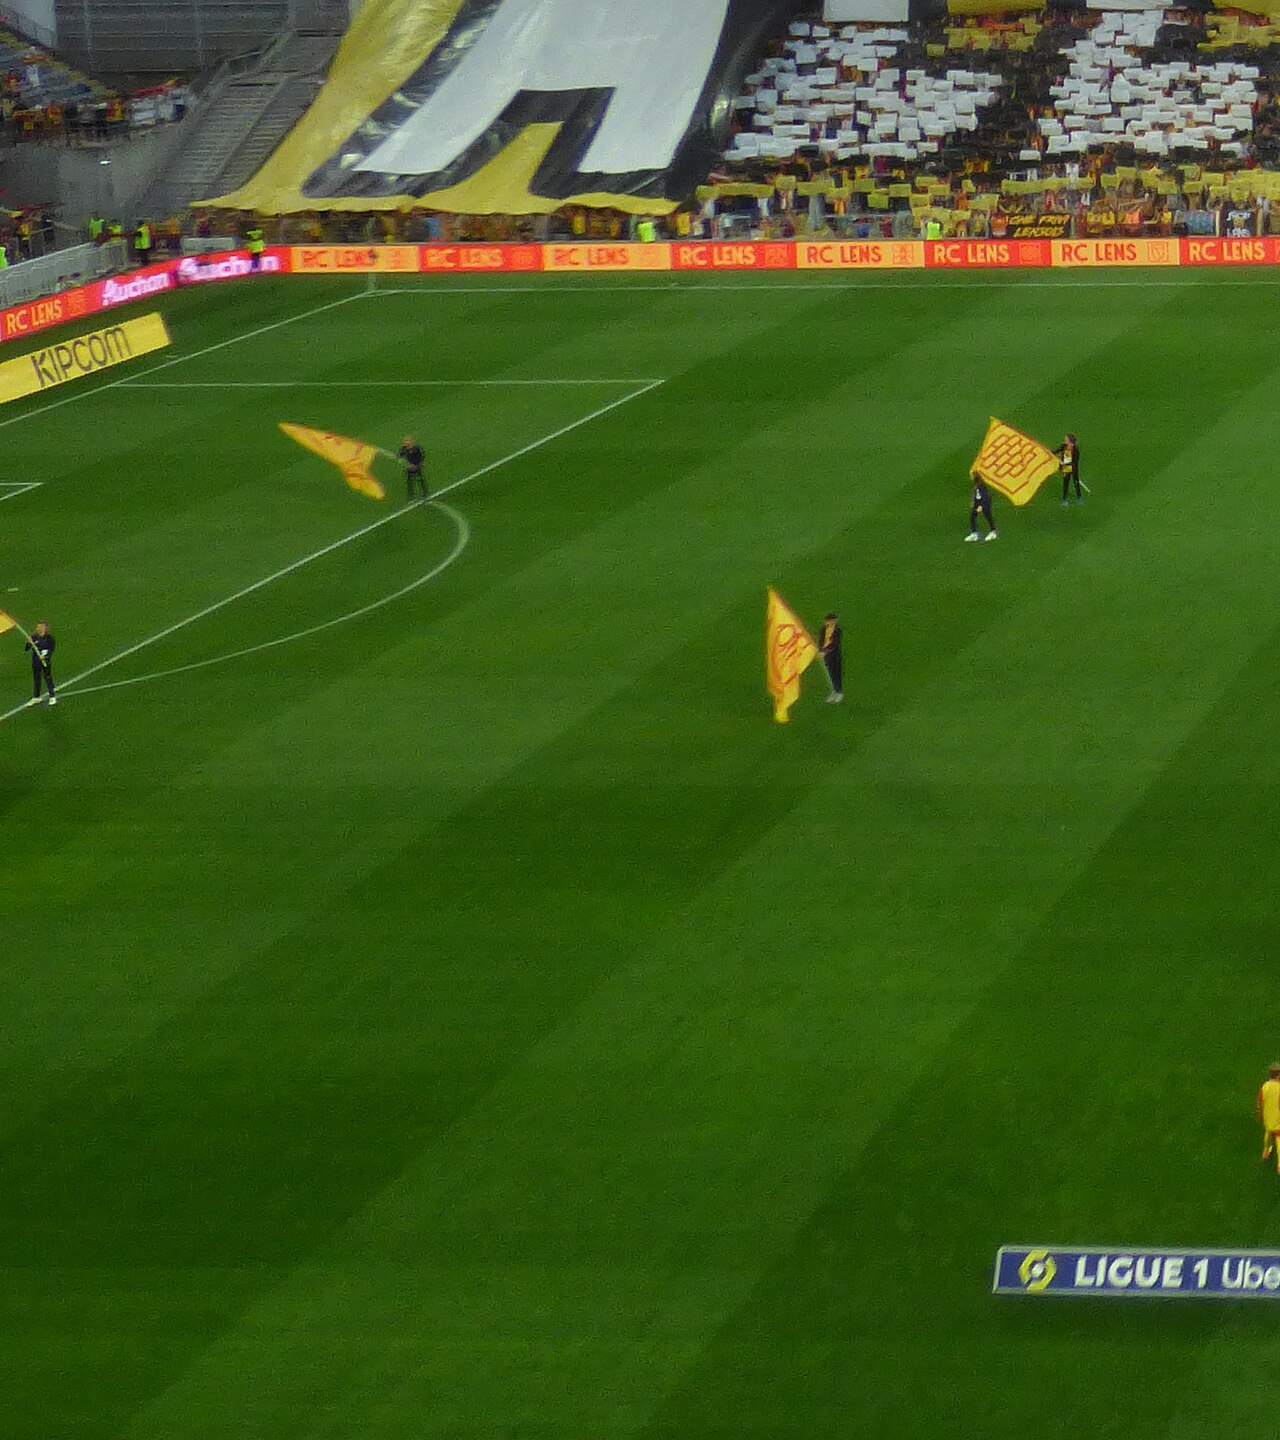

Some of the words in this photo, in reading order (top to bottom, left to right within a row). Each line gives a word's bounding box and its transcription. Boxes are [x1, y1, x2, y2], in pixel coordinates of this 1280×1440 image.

[427, 248, 450, 267] RC
[459, 248, 503, 267] LENS
[588, 248, 628, 266] LENS
[680, 246, 707, 265] RC
[714, 246, 756, 265] LENS
[807, 246, 833, 264] RC
[840, 246, 882, 264] LENS
[934, 245, 960, 264] RC
[967, 245, 1010, 264] LENS
[1061, 243, 1088, 262] RC
[1095, 243, 1137, 262] LENS
[1189, 242, 1215, 261] RC
[1222, 242, 1265, 261] LENS
[101, 272, 169, 307] Auchan
[5, 307, 28, 336] RC
[30, 299, 63, 327] LENS
[1074, 1255, 1183, 1289] LIGUE
[1194, 1259, 1207, 1289] 1
